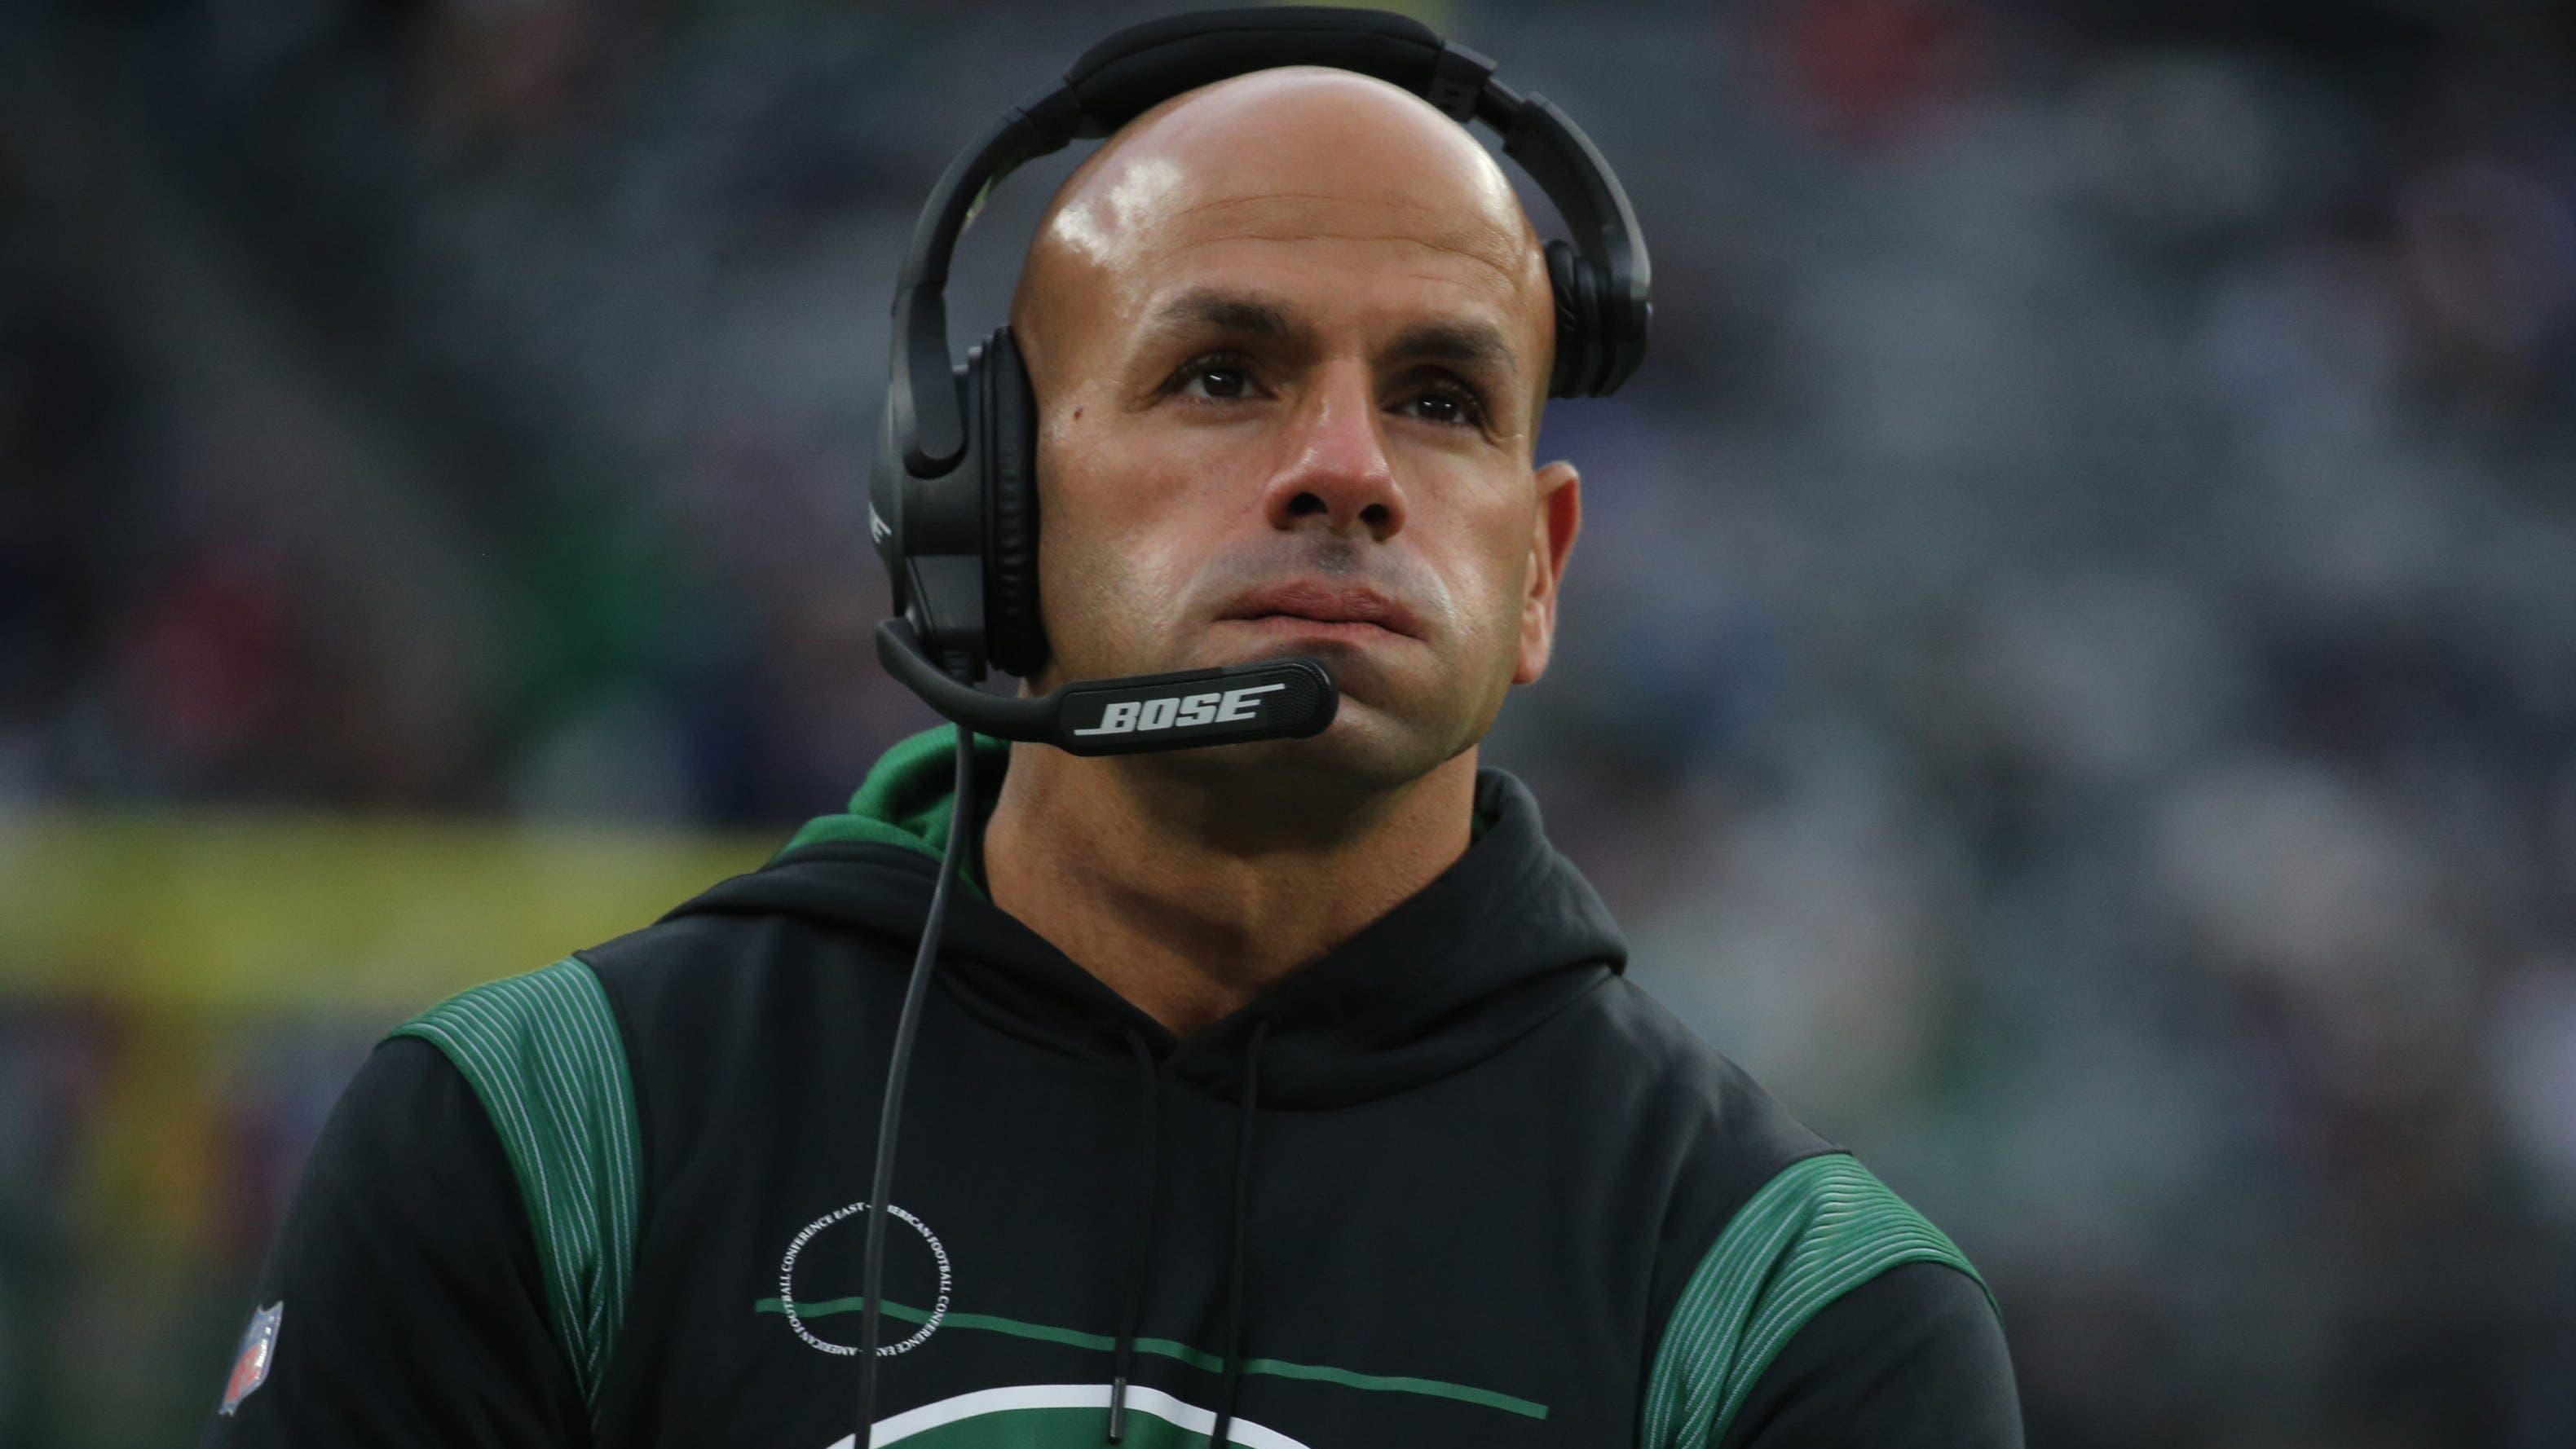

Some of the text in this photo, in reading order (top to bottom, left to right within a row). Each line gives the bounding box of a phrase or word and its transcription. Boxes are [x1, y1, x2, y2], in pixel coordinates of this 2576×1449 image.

[1074, 683, 1286, 736] BOSE
[781, 1214, 835, 1272] CONFERENCE
[926, 1236, 952, 1293] FOOTBALL
[779, 1273, 805, 1333] FOOTBALL
[895, 1295, 950, 1354] CONFERENCE
